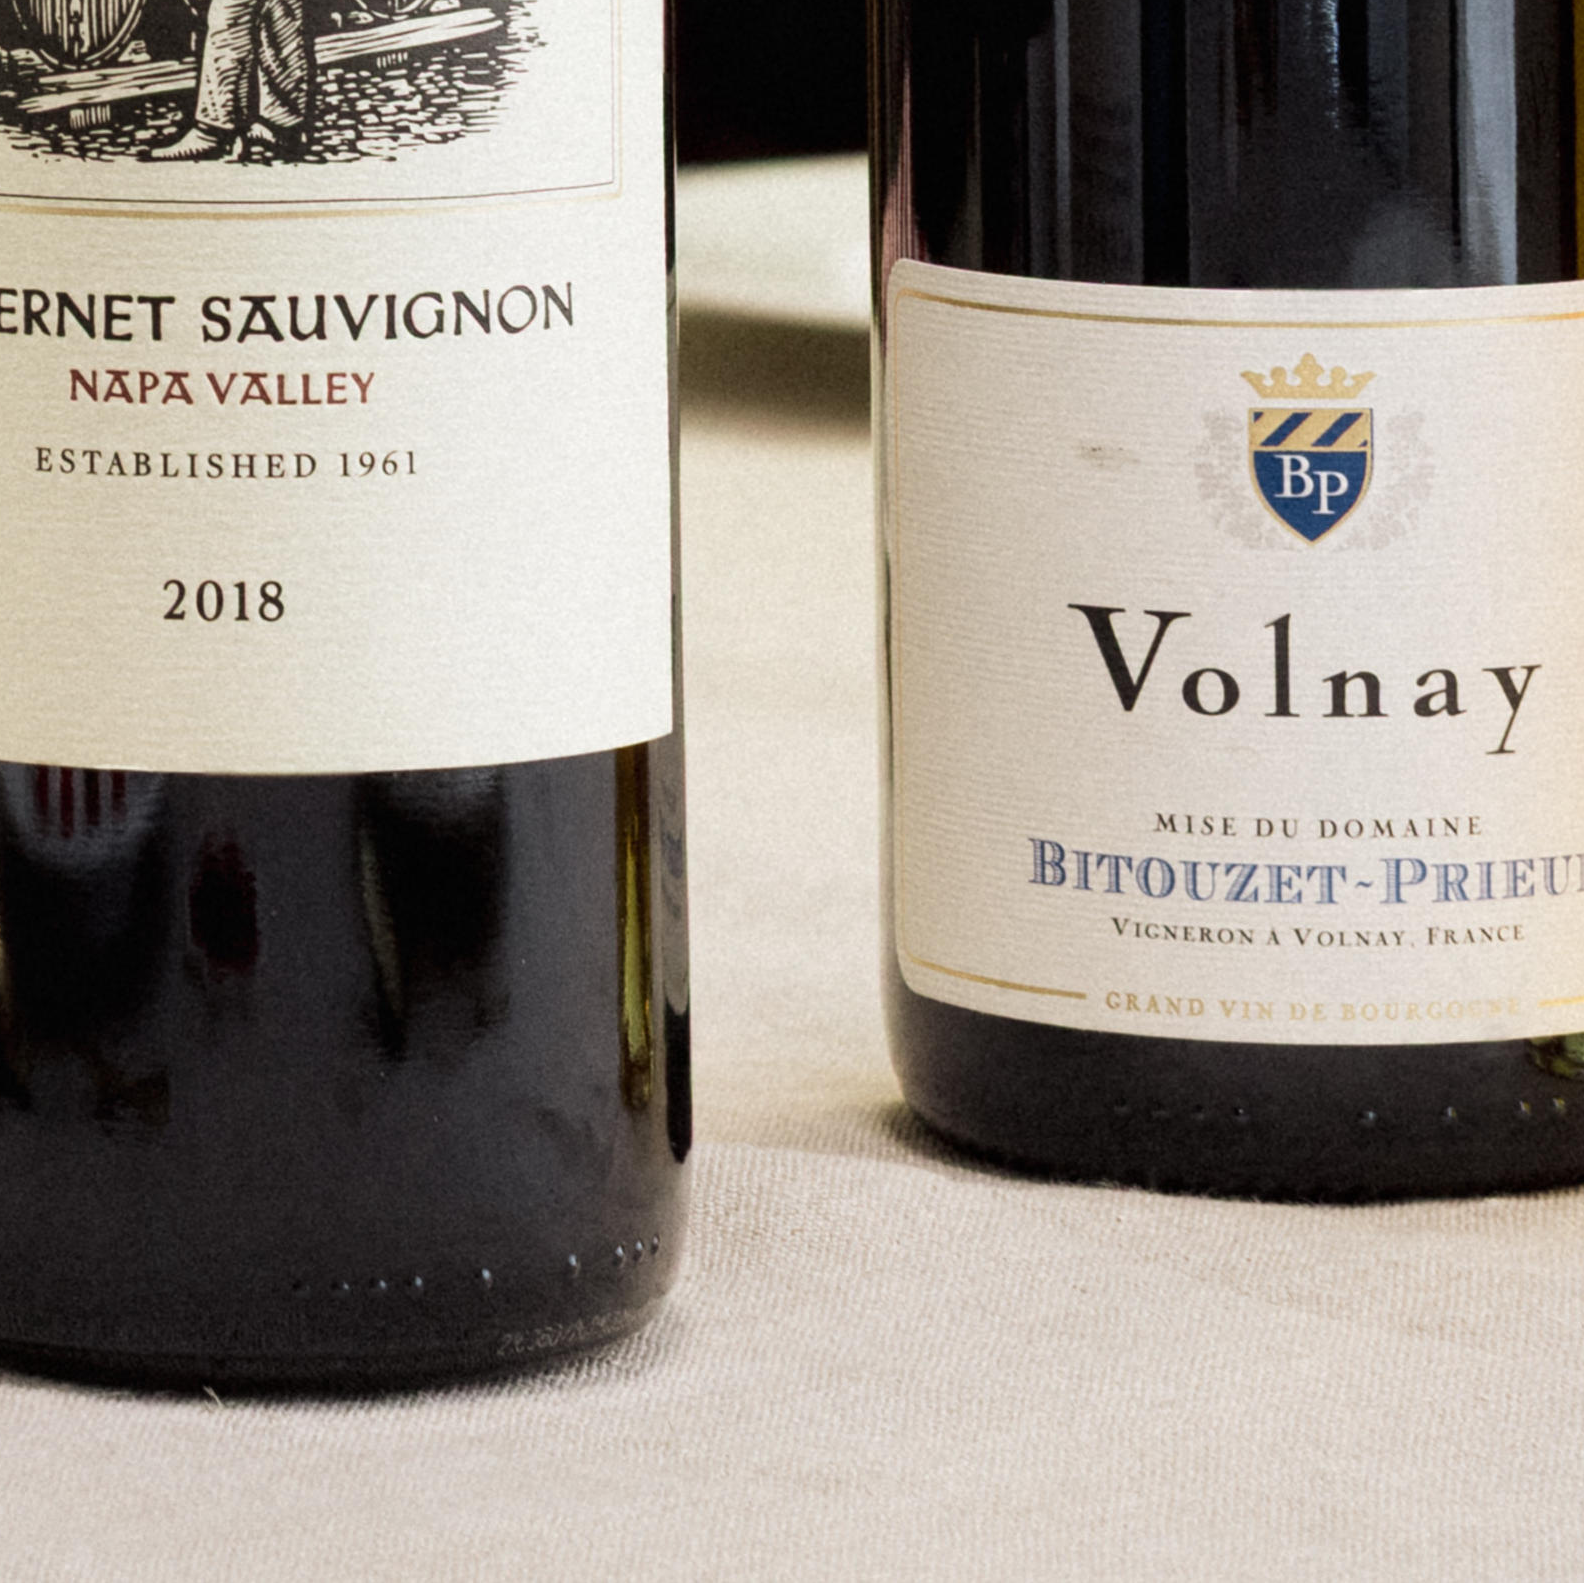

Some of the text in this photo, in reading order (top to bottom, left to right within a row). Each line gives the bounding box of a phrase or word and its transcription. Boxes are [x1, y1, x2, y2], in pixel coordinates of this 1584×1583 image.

[202, 281, 574, 343] SAUVIGNON
[69, 368, 375, 405] NAPA VALLEY
[35, 446, 418, 479] ESTABLISHED 1961
[1274, 454, 1349, 515] BP
[163, 579, 286, 622] 2018
[1066, 603, 1542, 756] Volnay
[1153, 812, 1482, 839] MISE DU DOMAINE
[1111, 916, 1255, 946] VIGNERON
[1427, 924, 1525, 946] FRANCE
[1105, 991, 1205, 1017] GRAND
[1219, 999, 1274, 1021] VIN
[1289, 1002, 1328, 1022] DE
